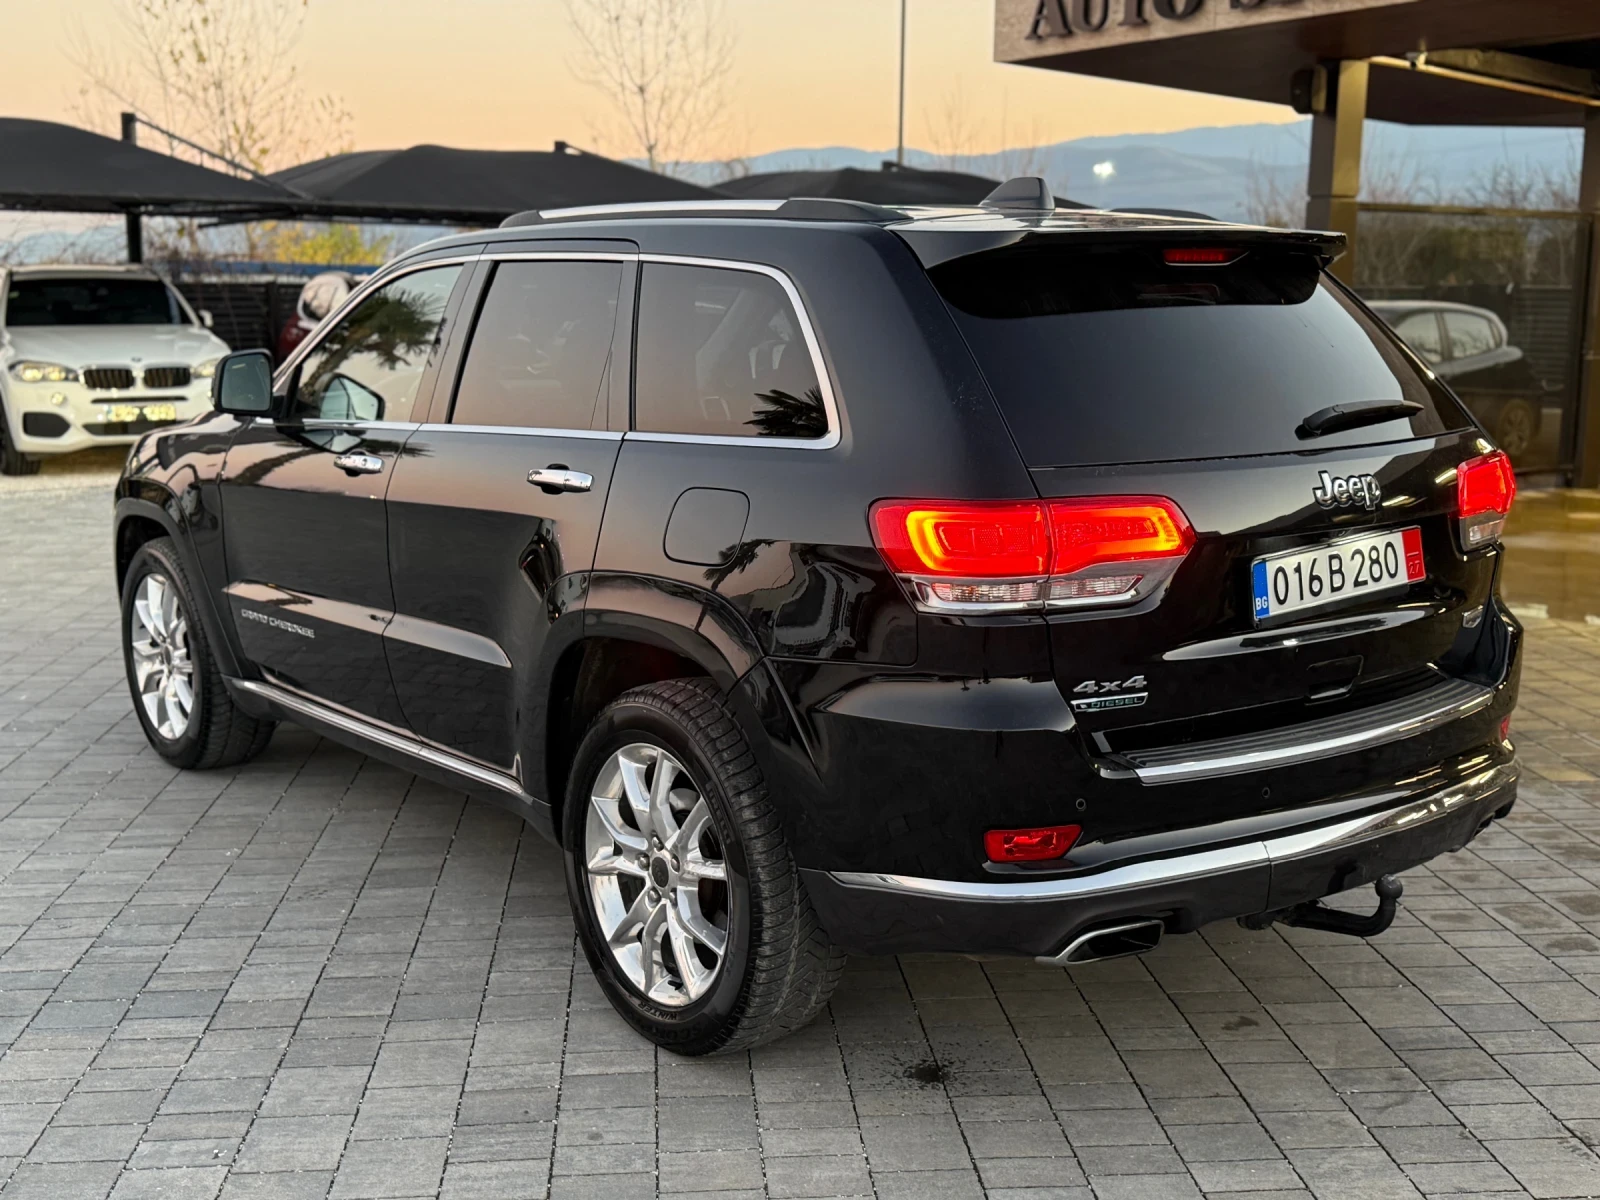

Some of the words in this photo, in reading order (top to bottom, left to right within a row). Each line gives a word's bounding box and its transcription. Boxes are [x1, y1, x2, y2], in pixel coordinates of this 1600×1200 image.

[1312, 470, 1381, 510] Jeep
[1256, 596, 1268, 610] BG
[241, 608, 268, 624] GRAND
[269, 617, 315, 639] CHEROKEE
[1073, 675, 1147, 693] 4x4
[637, 1001, 679, 1021] WINTER
